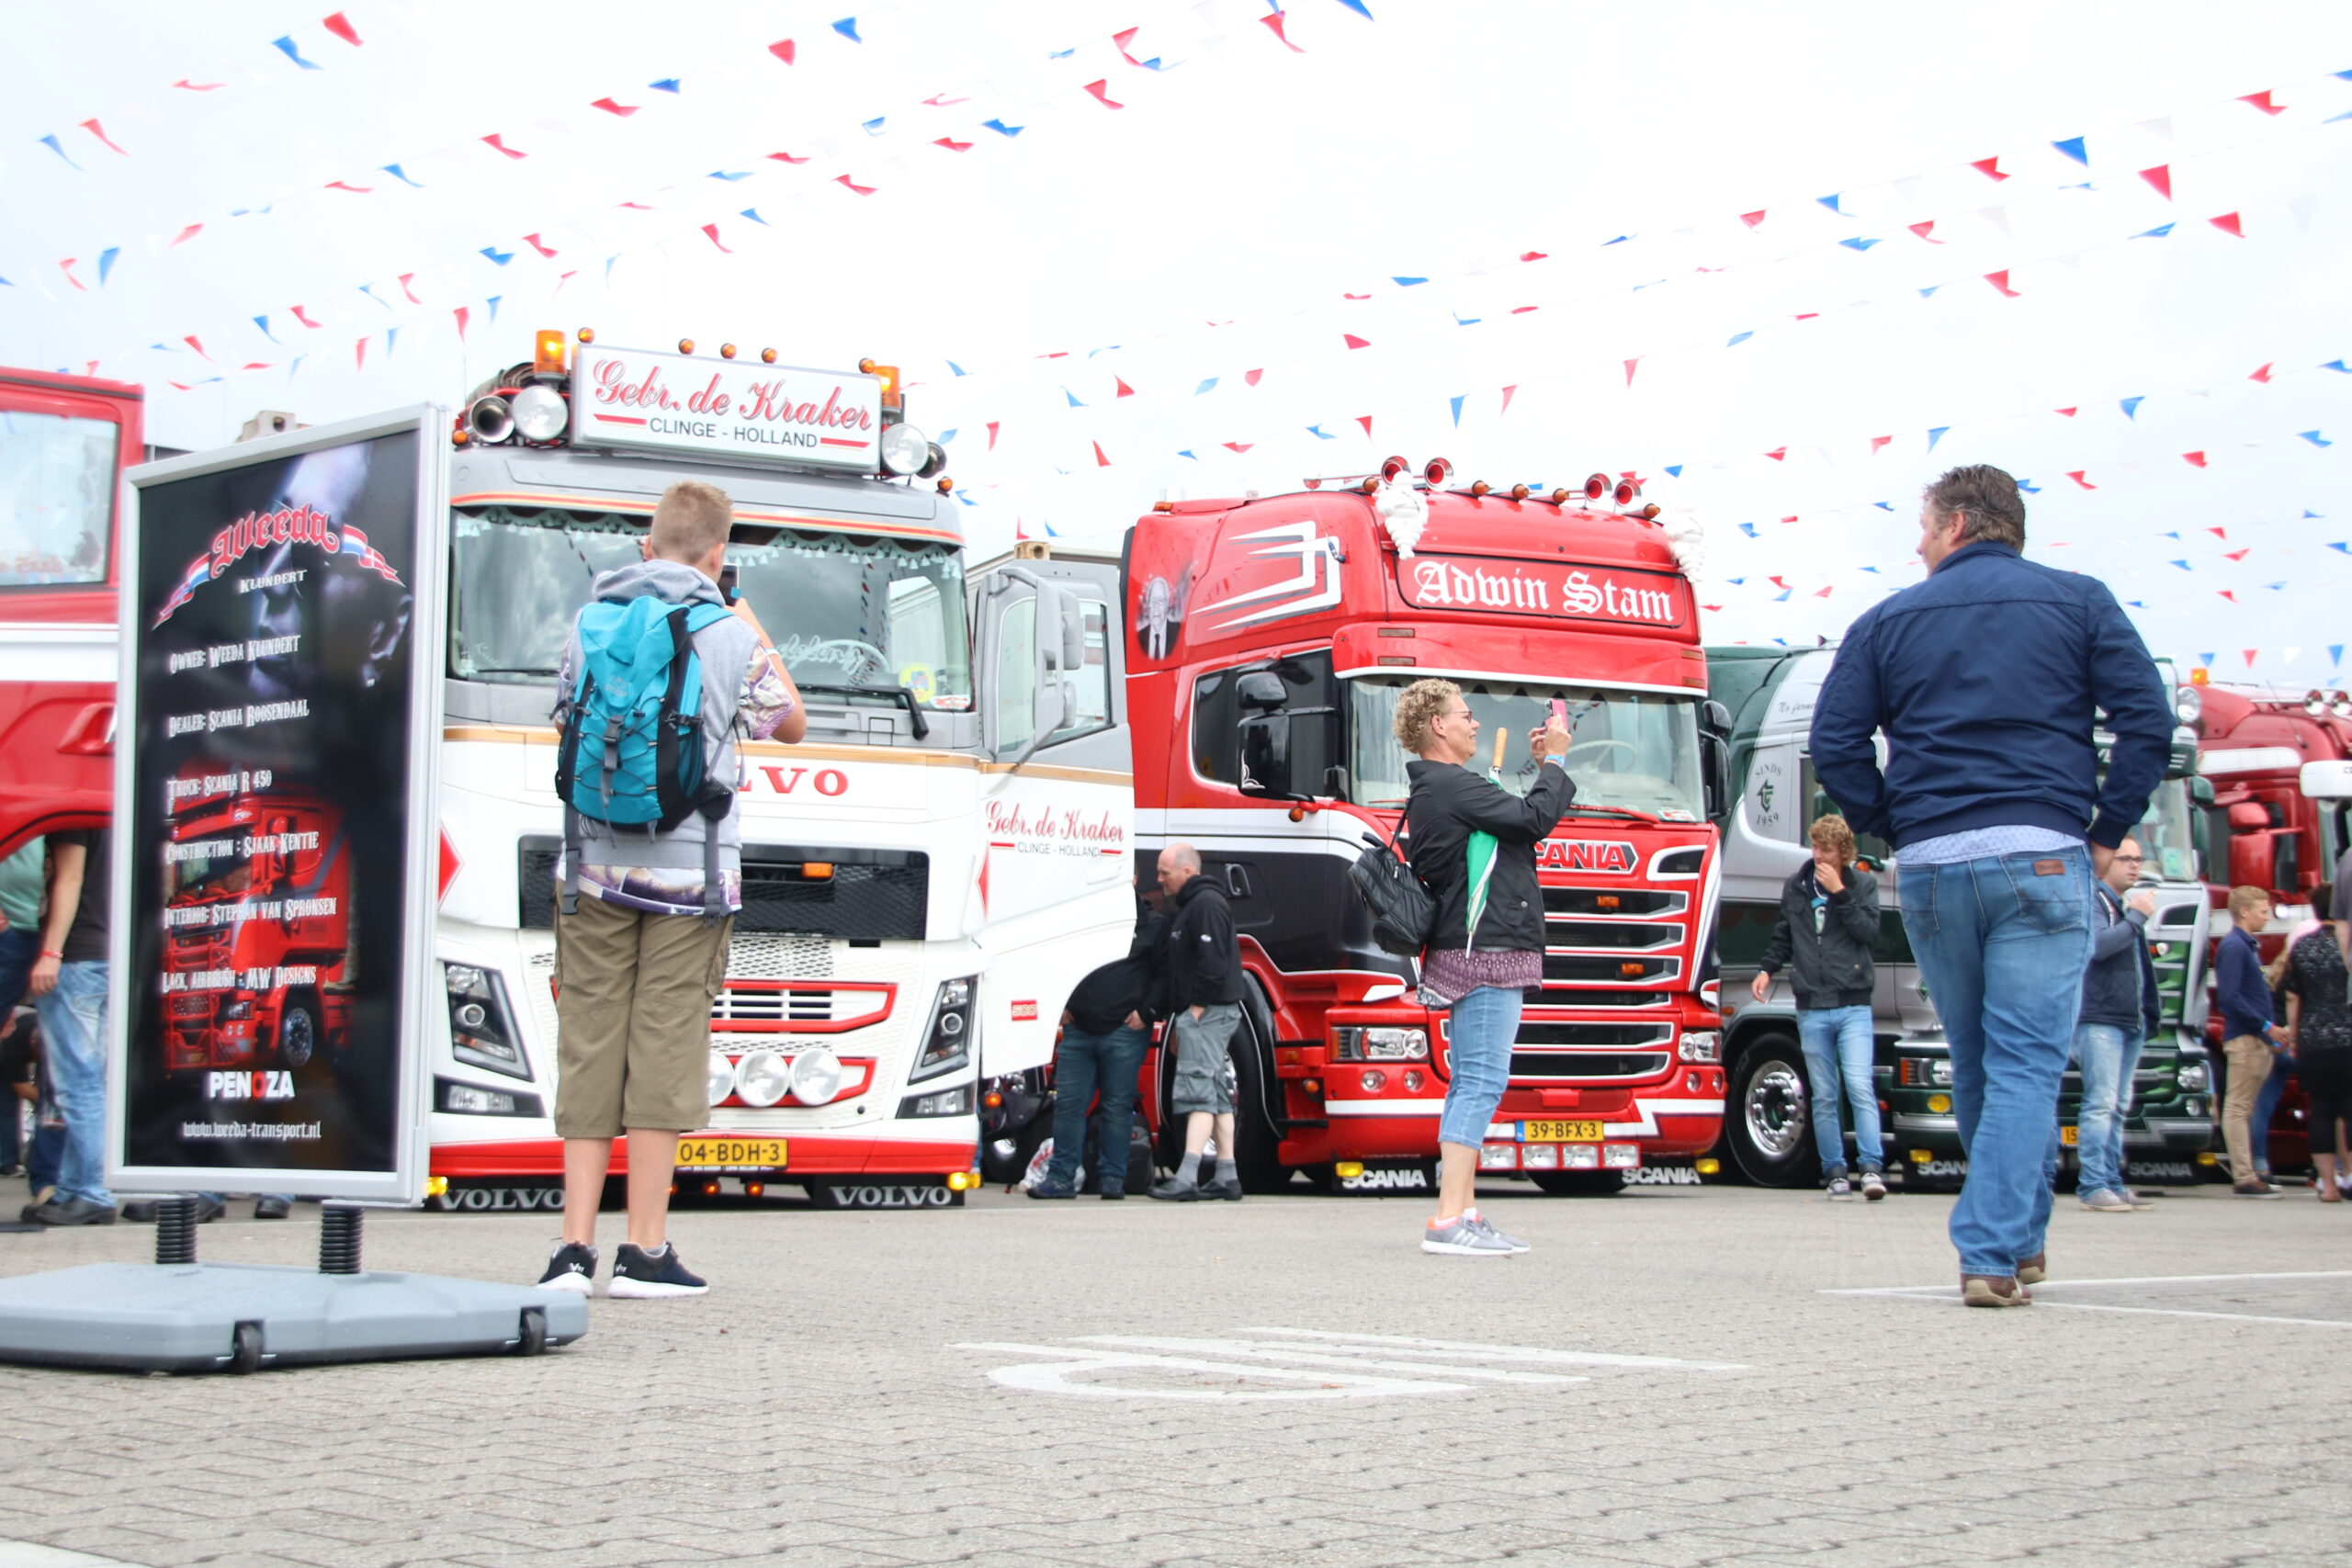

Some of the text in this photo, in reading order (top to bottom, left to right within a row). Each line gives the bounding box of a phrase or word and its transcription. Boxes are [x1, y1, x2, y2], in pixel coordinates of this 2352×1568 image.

[593, 358, 873, 431] Gebr. de Kraker
[650, 418, 718, 439] CLINGE
[734, 426, 818, 448] HOLLAND
[1414, 560, 1674, 622] Adwin Stam
[242, 772, 250, 793] R
[253, 770, 273, 788] 450
[1035, 806, 1057, 837] de
[1017, 841, 1051, 854] CLINGE
[1058, 845, 1101, 858] HOLLAND
[1533, 841, 1629, 870] ANIA
[209, 1070, 296, 1098] PENOZA
[1530, 1122, 1597, 1138] 39-BFX-3
[680, 1143, 780, 1162] 04-BDH-3
[1621, 1166, 1702, 1184] SCANIA
[1917, 1160, 1970, 1176] SCAN
[2129, 1162, 2192, 1177] SCANIA
[438, 1188, 566, 1210] VOLVO
[829, 1186, 953, 1206] VOLVO
